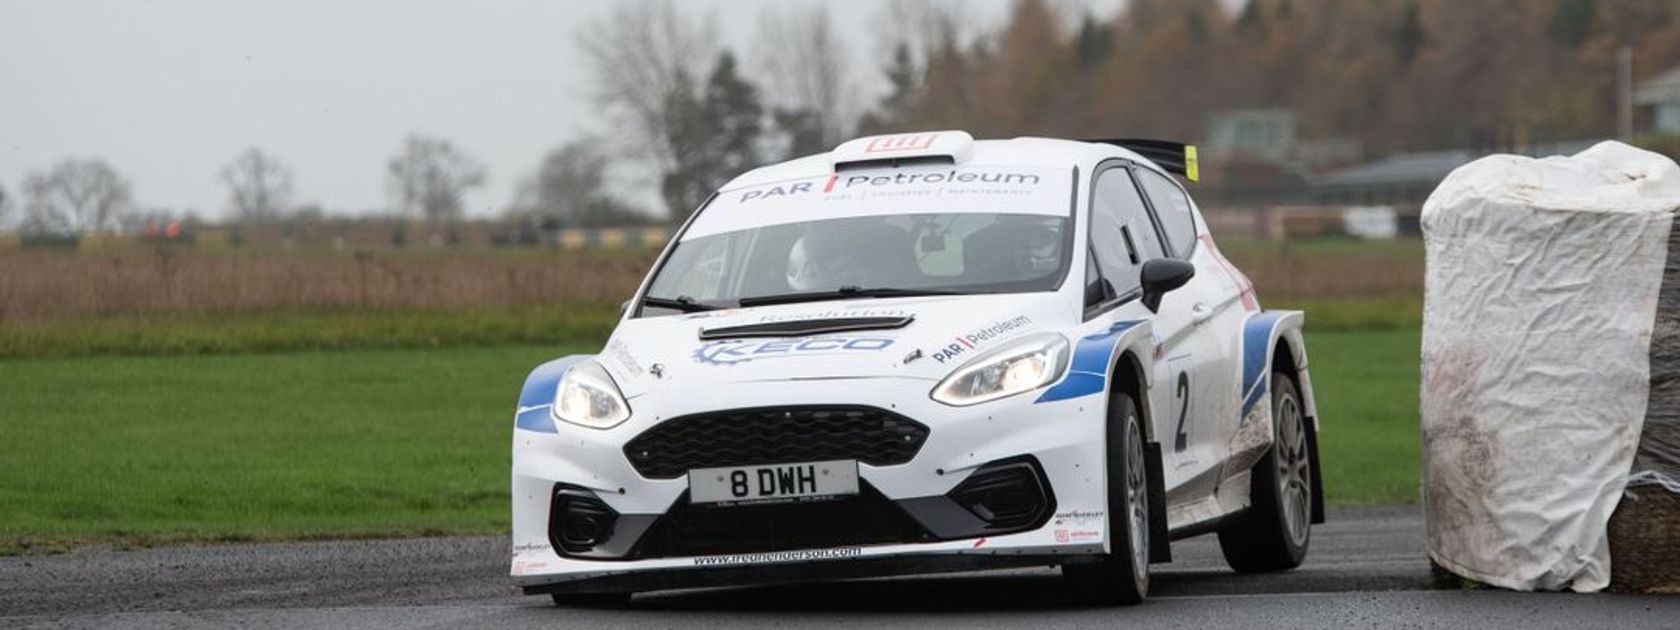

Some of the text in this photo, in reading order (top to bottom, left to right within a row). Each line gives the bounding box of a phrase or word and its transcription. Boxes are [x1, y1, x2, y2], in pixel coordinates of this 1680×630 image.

[740, 170, 1041, 202] PAR Petroleum
[709, 337, 896, 358] KECO
[932, 314, 1033, 364] PAR Petroleum
[1174, 370, 1189, 453] 2
[731, 464, 818, 498] 8 DWH
